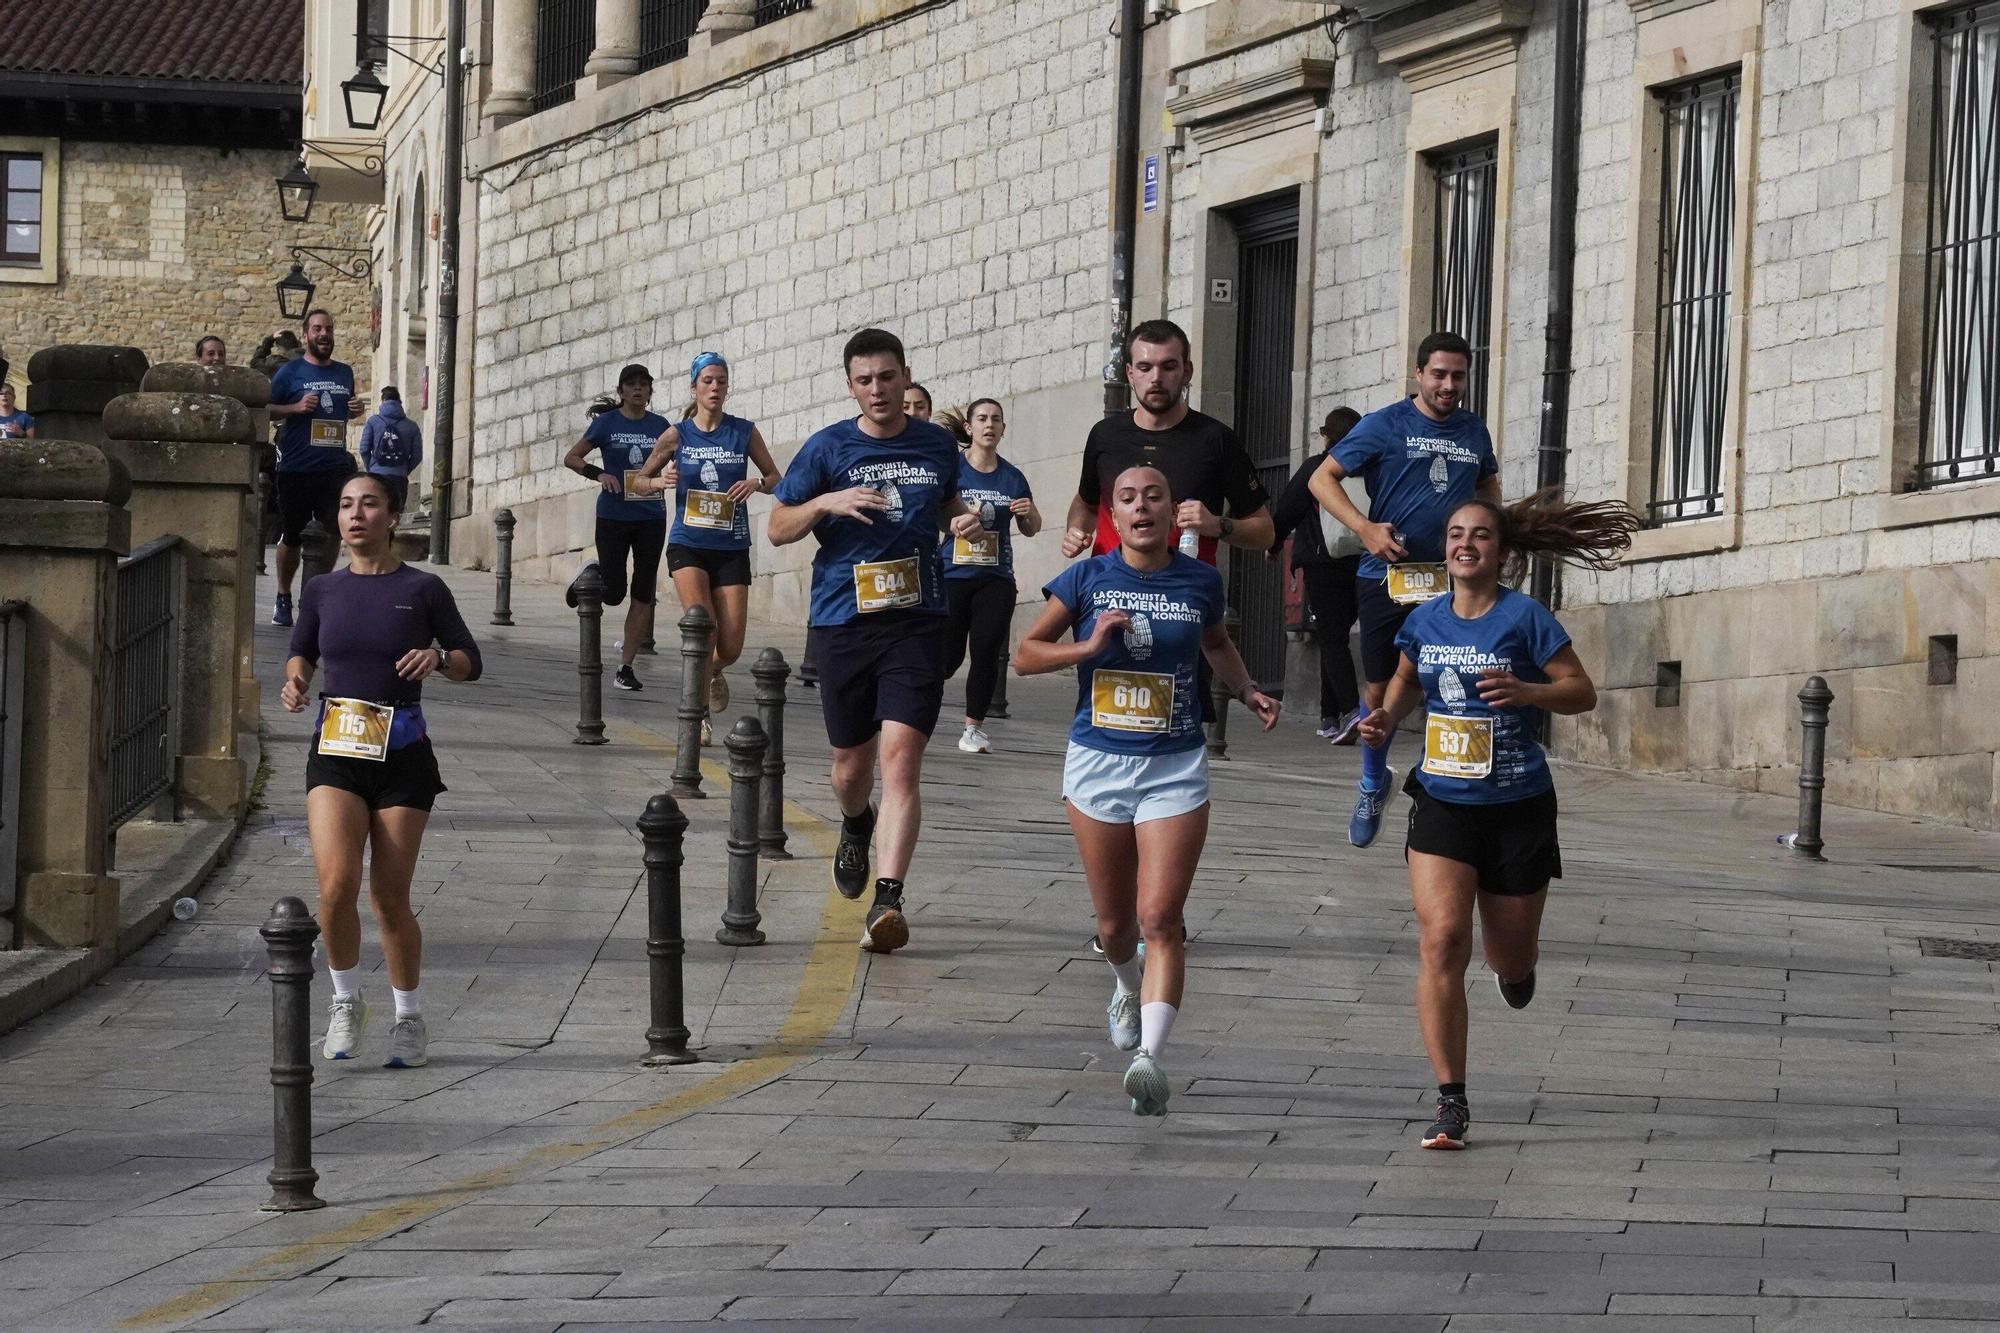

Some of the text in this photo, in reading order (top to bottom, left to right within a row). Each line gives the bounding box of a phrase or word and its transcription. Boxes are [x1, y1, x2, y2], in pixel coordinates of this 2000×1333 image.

[1215, 282, 1228, 298] 5
[323, 426, 337, 437] 179
[1416, 437, 1457, 447] CONQUISTA
[690, 451, 736, 459] ALMENDRA
[1419, 443, 1471, 456] ALMENDRA
[1447, 454, 1479, 464] KONKISTA
[848, 461, 908, 477] LA CONQUISTA
[863, 467, 928, 483] ALMENDRA
[897, 477, 938, 485] KONKISTA
[699, 500, 722, 515] 513
[874, 571, 906, 593] 644
[1404, 572, 1435, 589] 509
[1093, 590, 1168, 602] LA CONQUISTA
[1108, 598, 1190, 613] ALMENDRA
[1152, 612, 1201, 624] KONKISTA
[1424, 645, 1476, 655] CONQUISTA
[1422, 653, 1498, 665] ALMENDRA
[1114, 685, 1151, 710] 610
[338, 713, 367, 736] 115
[1440, 730, 1470, 755] 537
